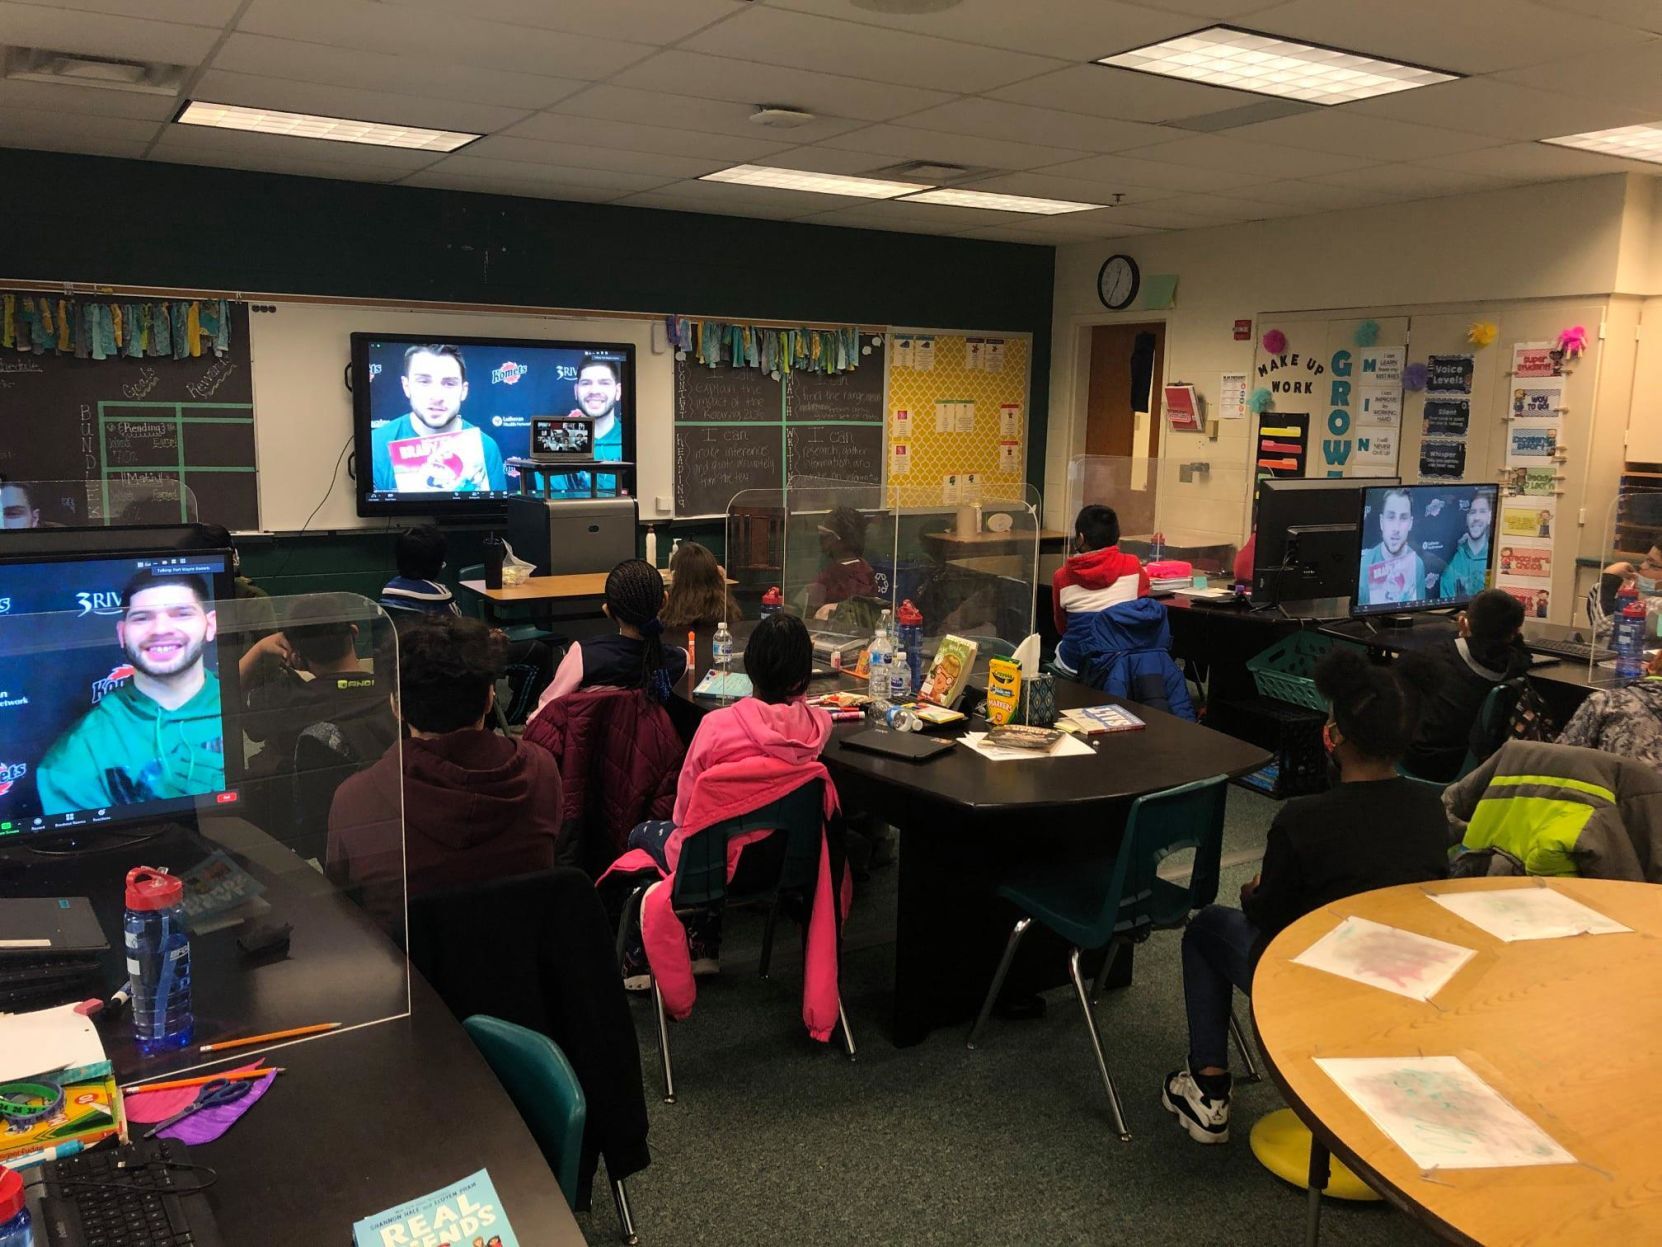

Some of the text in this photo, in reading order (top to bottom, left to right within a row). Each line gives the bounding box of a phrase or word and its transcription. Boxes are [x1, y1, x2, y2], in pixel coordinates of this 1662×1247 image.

[492, 363, 528, 385] Komets
[1258, 354, 1324, 377] MAKE UP
[1435, 365, 1463, 373] Voice
[122, 367, 156, 398] Goals
[1272, 381, 1312, 394] WORK
[1432, 375, 1464, 384] Levels
[1323, 350, 1352, 477] GROW
[701, 427, 750, 442] I can
[808, 427, 854, 444] I can
[677, 432, 685, 508] READING
[76, 592, 123, 617] 3RIV
[370, 1214, 403, 1231] SHANNON
[404, 1207, 420, 1219] HALE
[459, 1181, 478, 1196] PHAM
[379, 1194, 482, 1247] REAL
